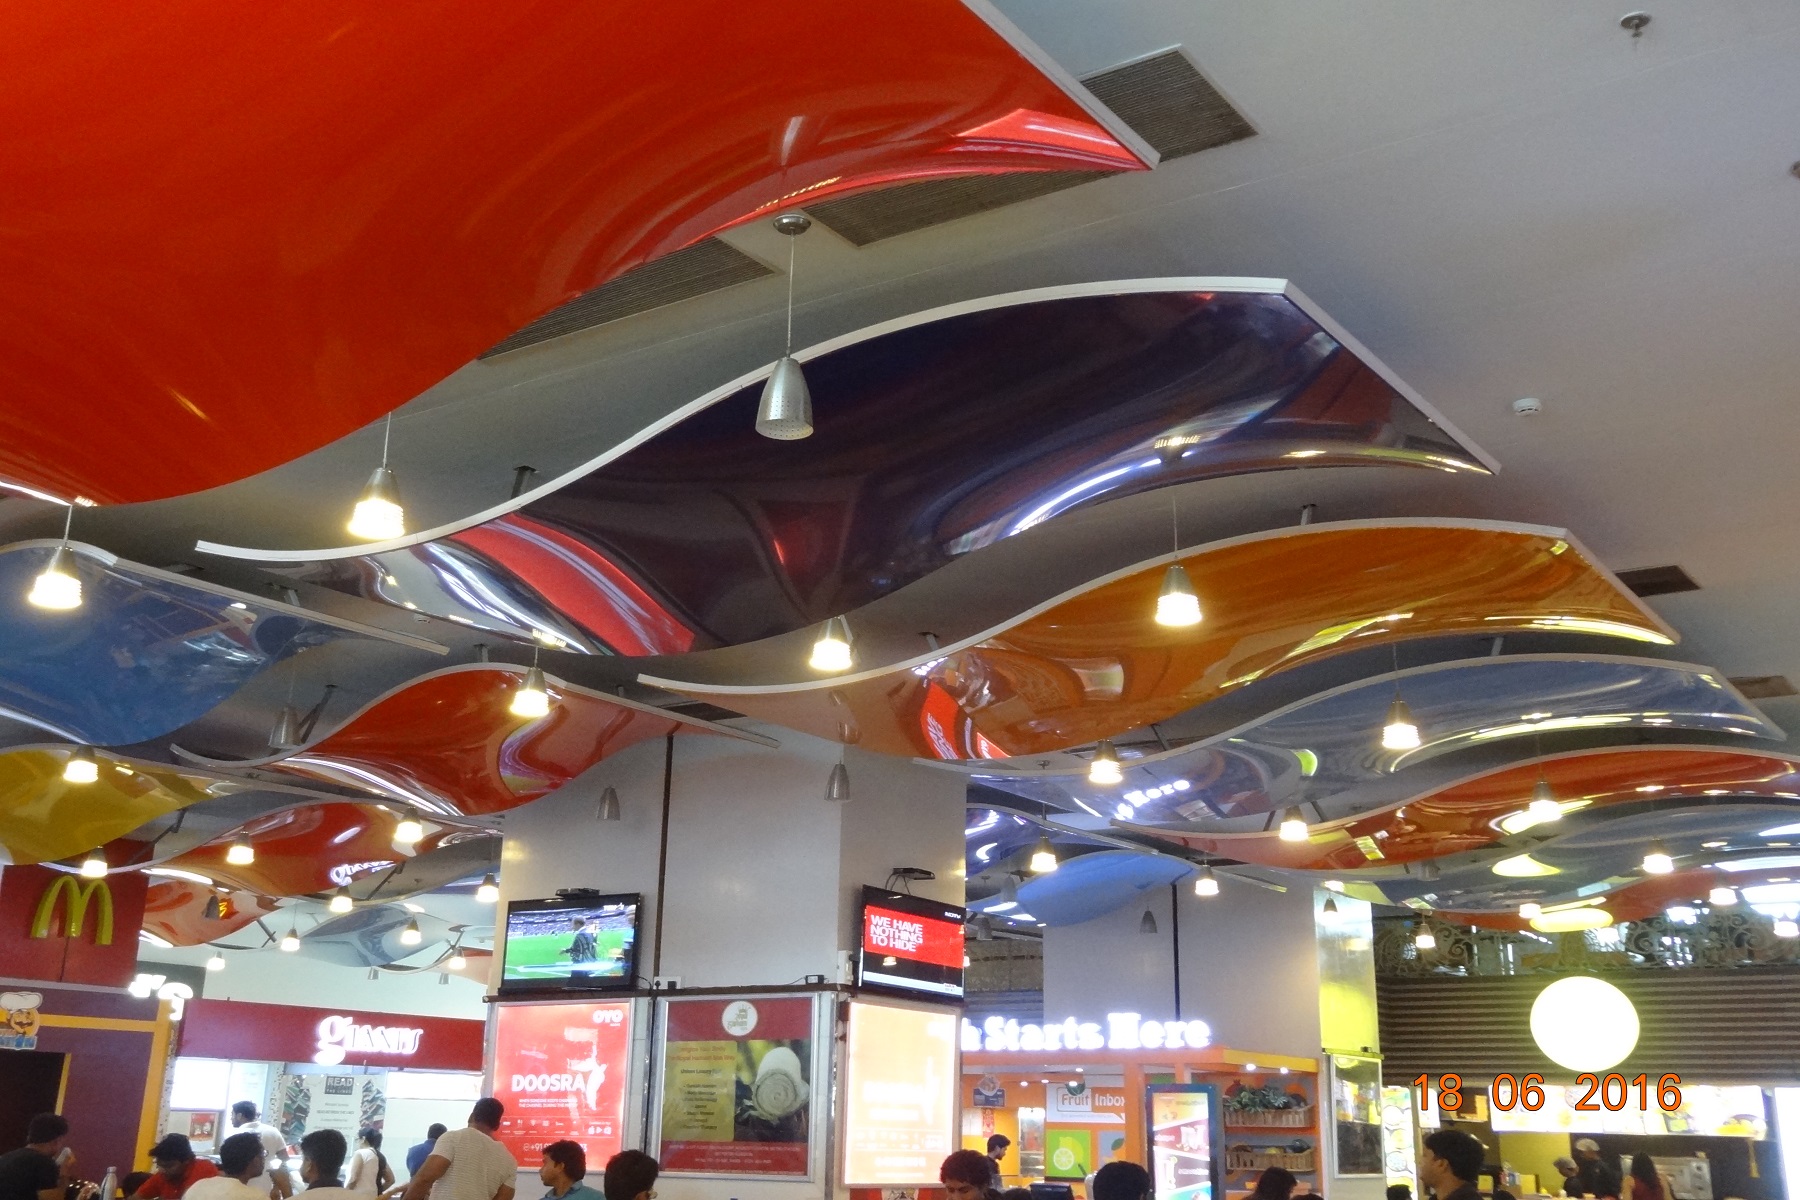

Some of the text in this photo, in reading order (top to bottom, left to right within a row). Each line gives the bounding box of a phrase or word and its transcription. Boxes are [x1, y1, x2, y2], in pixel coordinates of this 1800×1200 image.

[870, 914, 923, 934] WE HAVE
[870, 925, 923, 944] NOTHING
[870, 934, 917, 952] TO HIDE
[592, 1009, 623, 1023] OYO
[984, 1016, 1104, 1050] Starts
[1107, 1012, 1212, 1049] Here
[327, 1077, 353, 1087] READ
[511, 1074, 586, 1092] DOOSRA
[1061, 1094, 1089, 1106] Fruit
